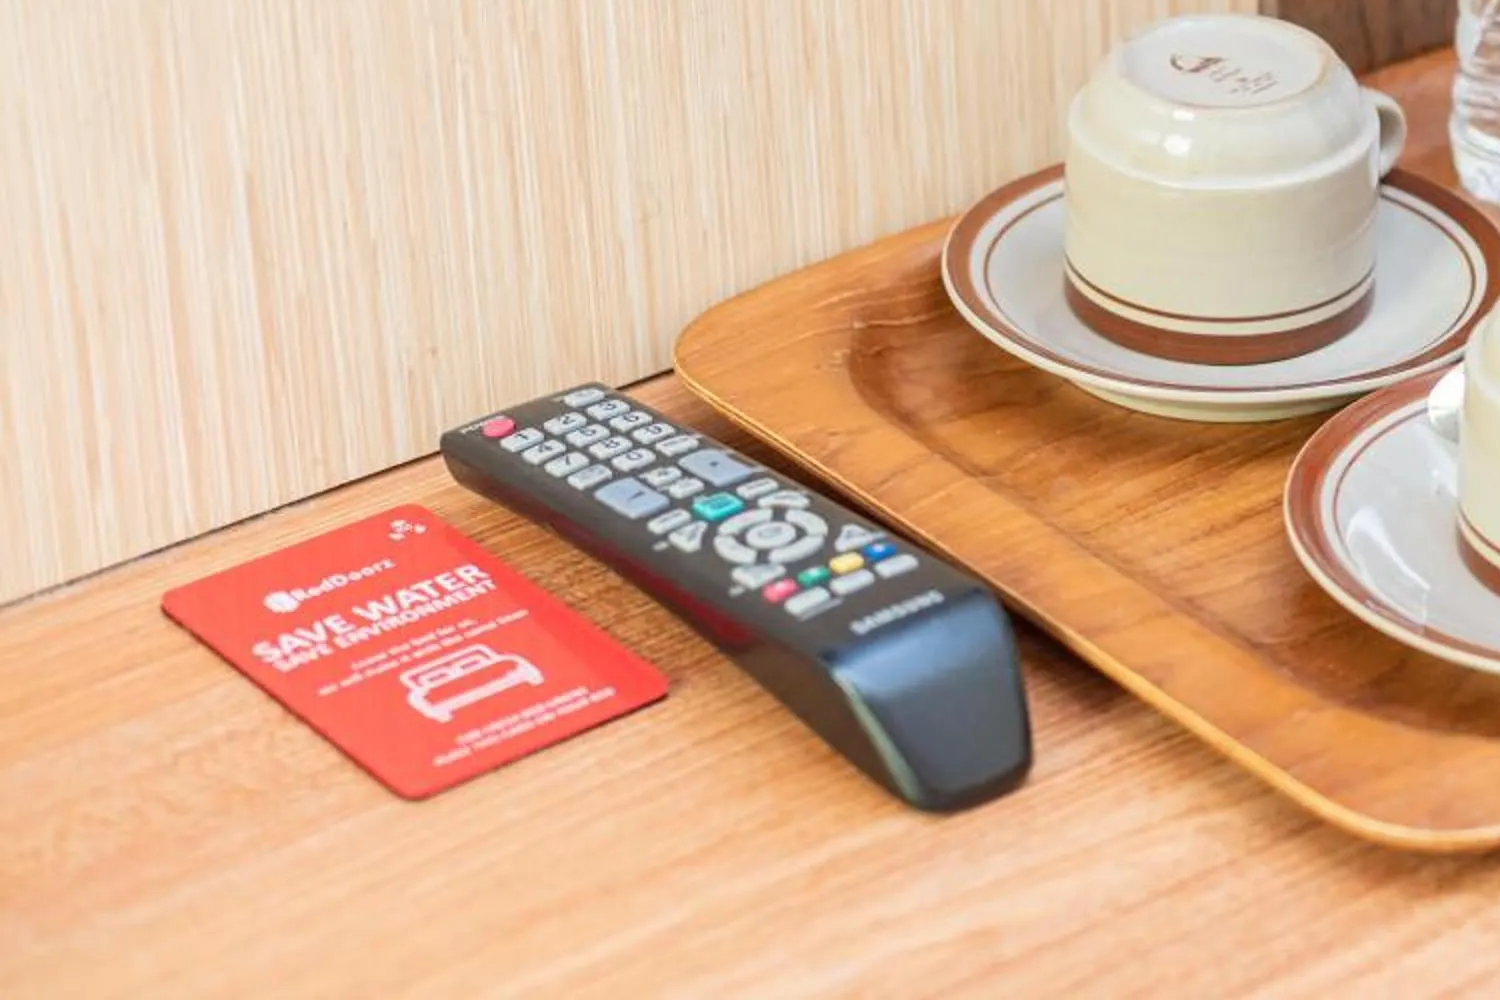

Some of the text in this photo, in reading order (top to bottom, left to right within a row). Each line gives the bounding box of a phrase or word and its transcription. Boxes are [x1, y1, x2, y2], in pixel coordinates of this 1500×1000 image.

[252, 613, 356, 663] SAVE
[352, 563, 492, 621] WATER
[333, 578, 497, 650] ENVIRONMENT
